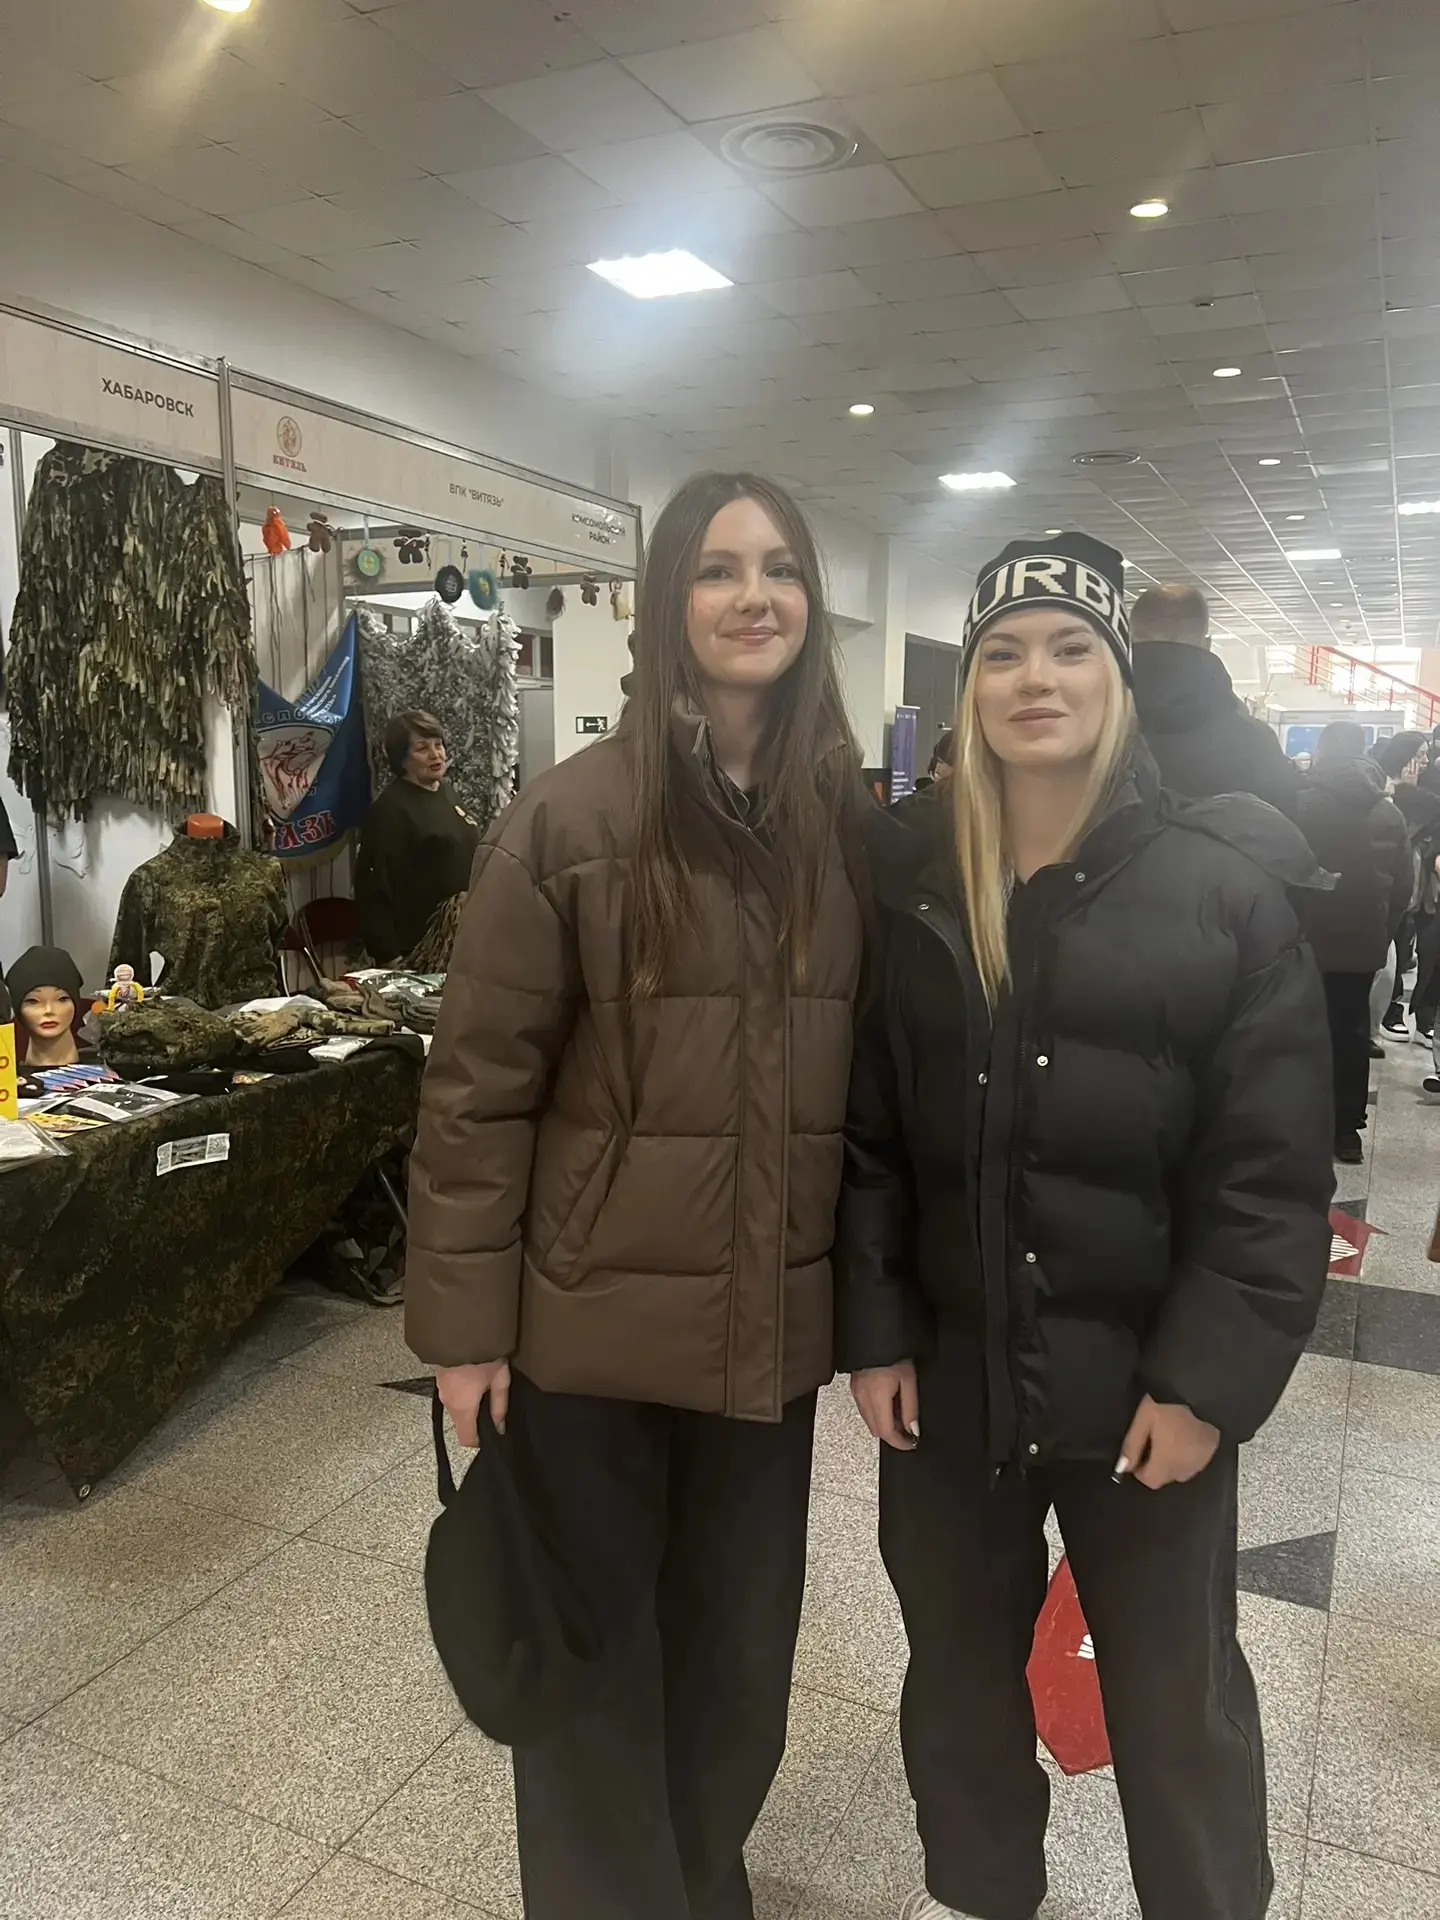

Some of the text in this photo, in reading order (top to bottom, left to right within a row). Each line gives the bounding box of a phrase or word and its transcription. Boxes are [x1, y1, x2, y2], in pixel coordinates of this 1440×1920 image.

[102, 377, 194, 418] ХАБАРОВСК
[449, 482, 468, 499] ВПК
[589, 531, 611, 545] РАЙОН
